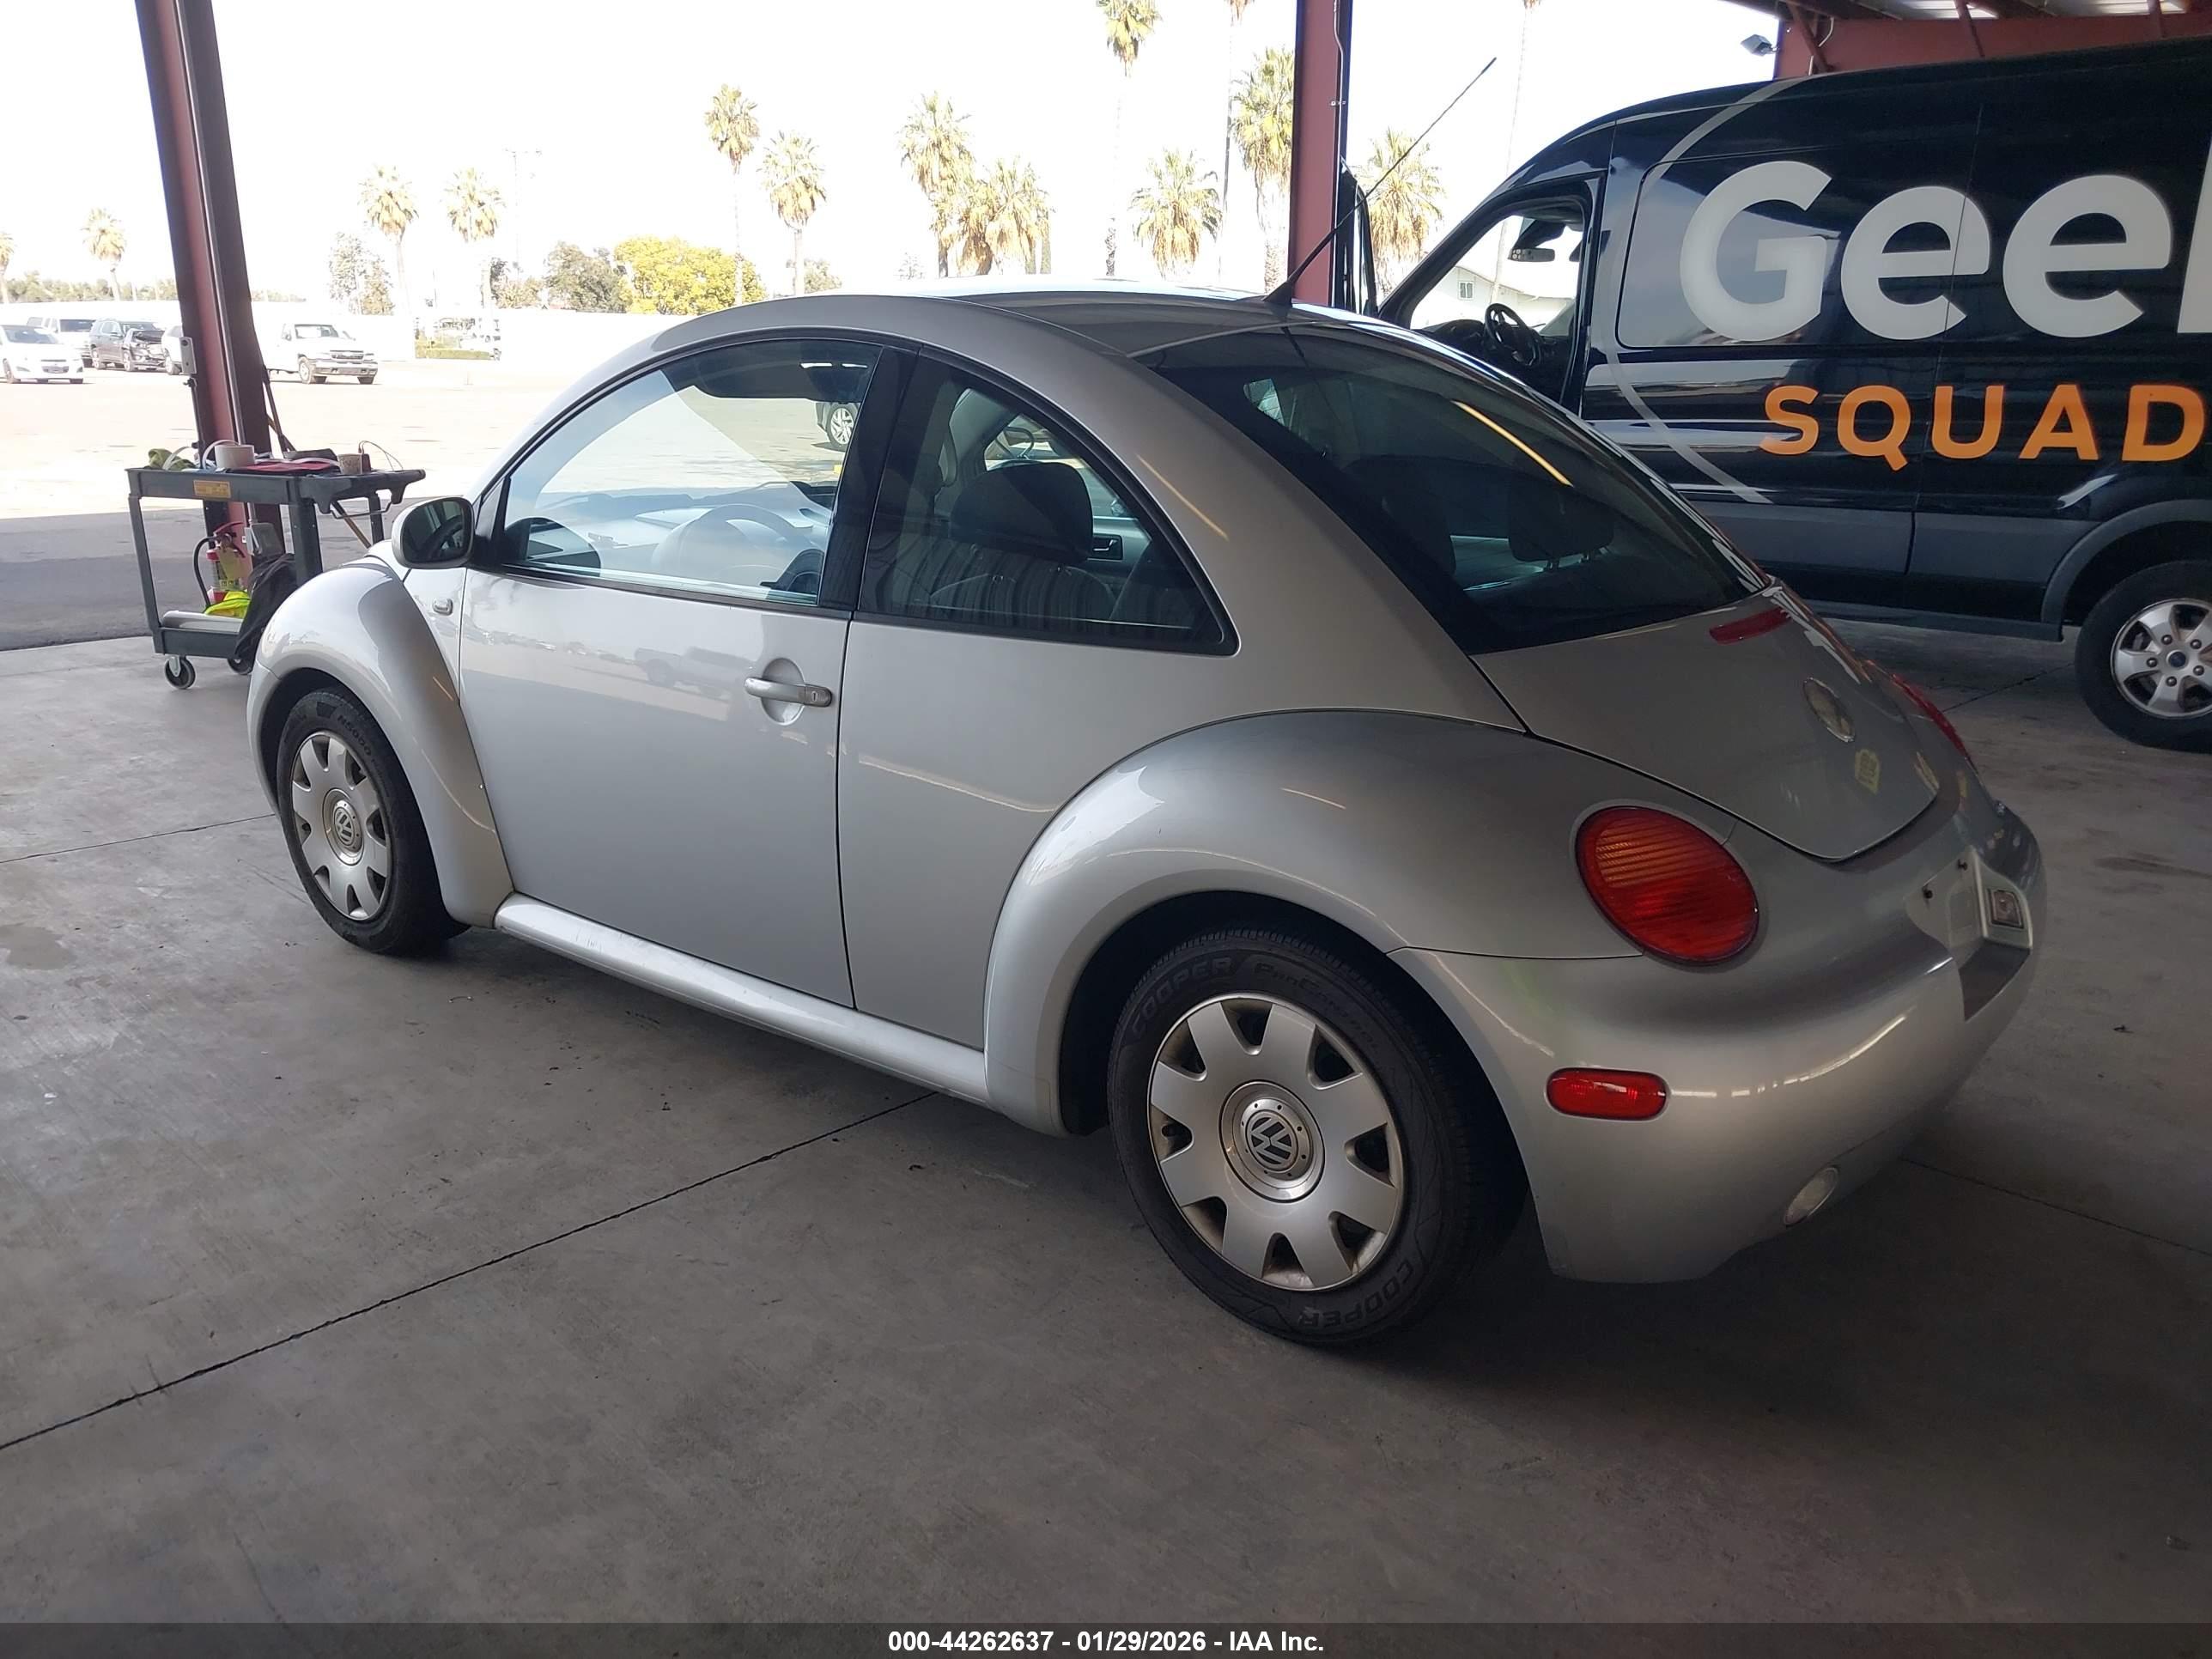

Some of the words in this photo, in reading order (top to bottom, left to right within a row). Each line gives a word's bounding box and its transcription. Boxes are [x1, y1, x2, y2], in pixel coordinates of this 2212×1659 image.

[1759, 383, 2206, 471] SQUAD
[1132, 955, 1234, 1038] COOPER
[1298, 1259, 1414, 1328] COOPER
